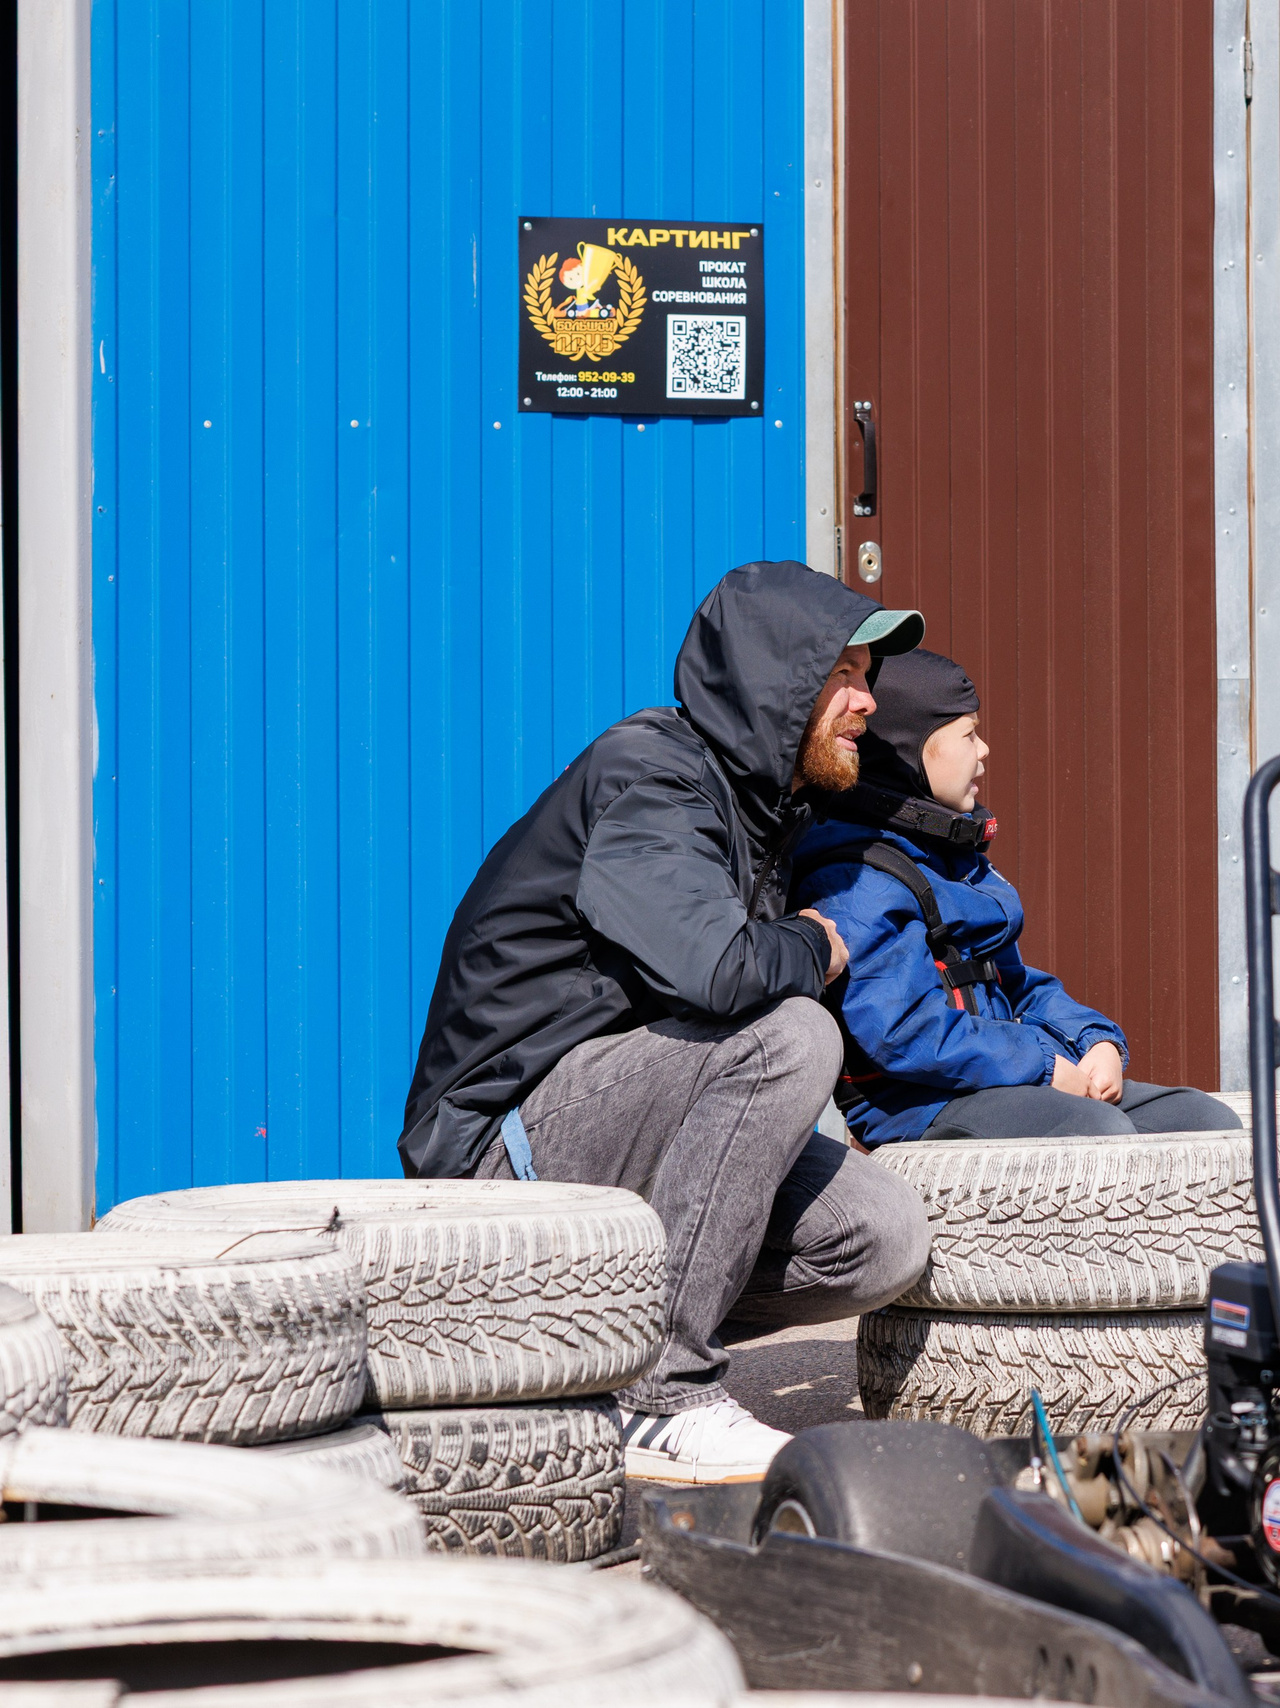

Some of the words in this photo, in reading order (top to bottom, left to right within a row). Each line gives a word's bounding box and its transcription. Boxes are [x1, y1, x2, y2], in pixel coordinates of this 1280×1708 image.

[607, 228, 750, 250] КАРТИНГ
[699, 261, 747, 274] ПРОКАТ
[702, 276, 747, 289] ШКОЛА
[652, 290, 747, 305] СОРЕВНОВАНИЯ
[556, 320, 614, 332] БОЛЬШОЙ
[555, 333, 614, 353] ПРИЗ
[535, 371, 577, 383] Телефон:
[578, 371, 635, 383] 952-09-39
[556, 387, 583, 397] 12:00
[590, 388, 617, 398] 21:00
